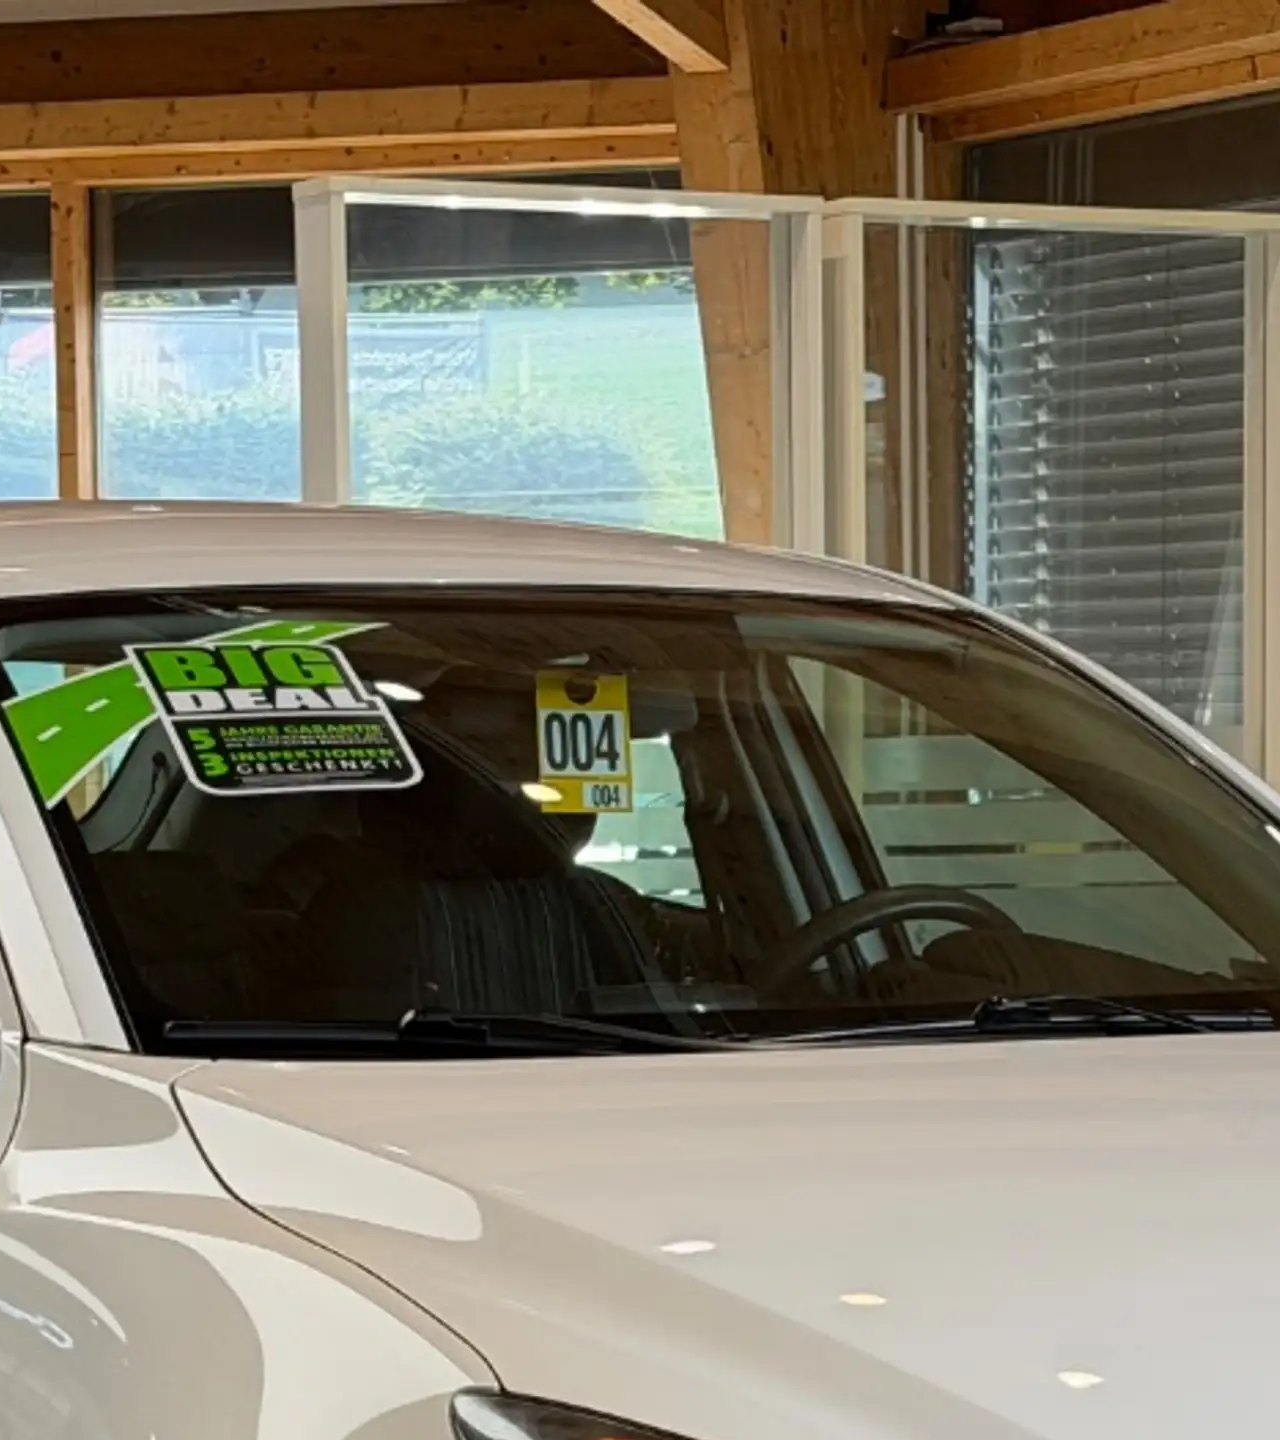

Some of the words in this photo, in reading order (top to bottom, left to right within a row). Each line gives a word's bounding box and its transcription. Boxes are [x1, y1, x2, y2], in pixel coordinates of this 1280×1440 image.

[144, 646, 345, 688] BIG
[165, 686, 370, 712] DEAL
[188, 727, 217, 750] 5
[220, 724, 280, 738] JAHRE
[282, 722, 384, 738] GARANTIE
[545, 712, 619, 771] 004
[198, 753, 230, 777] 3
[230, 747, 397, 762] INSPEKTIONEN
[236, 759, 403, 775] GESCHENKT!
[591, 783, 620, 808] 004
